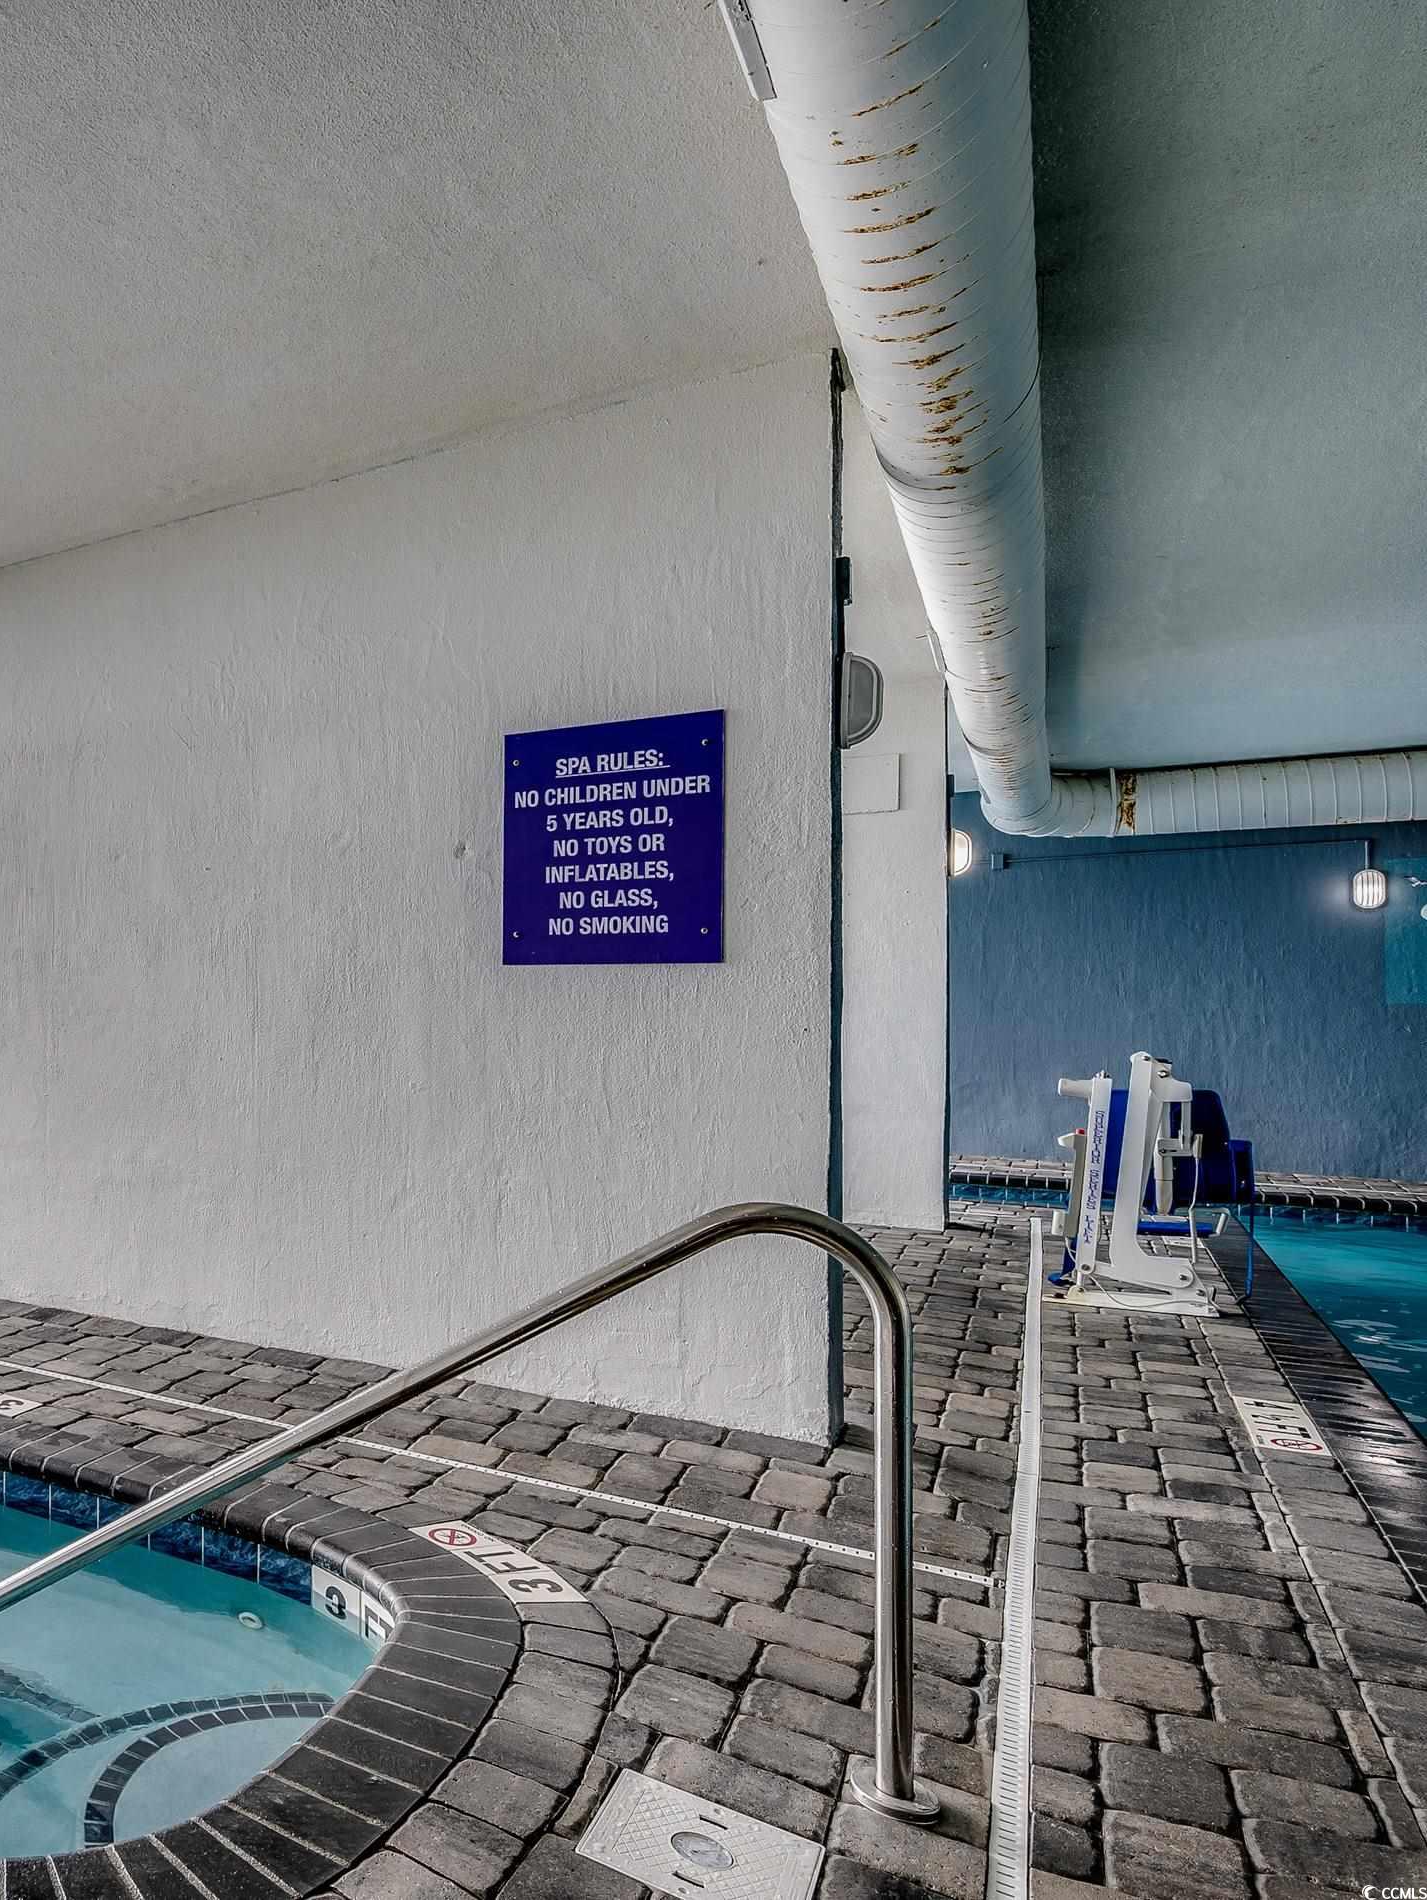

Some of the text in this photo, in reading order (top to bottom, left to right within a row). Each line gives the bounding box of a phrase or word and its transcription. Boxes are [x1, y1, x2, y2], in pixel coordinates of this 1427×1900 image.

[555, 749, 665, 776] SPA RULES:
[514, 775, 711, 809] NO CHILDREN UNDER
[546, 806, 674, 832] 5 YEARS OLD,
[553, 833, 665, 857] NO TOYS OR
[545, 860, 674, 884] INFLATABLES,
[559, 888, 658, 909] NO GLASS,
[548, 914, 669, 936] NO SMOKING
[463, 1548, 564, 1593] 3 FT
[325, 1585, 347, 1620] 3
